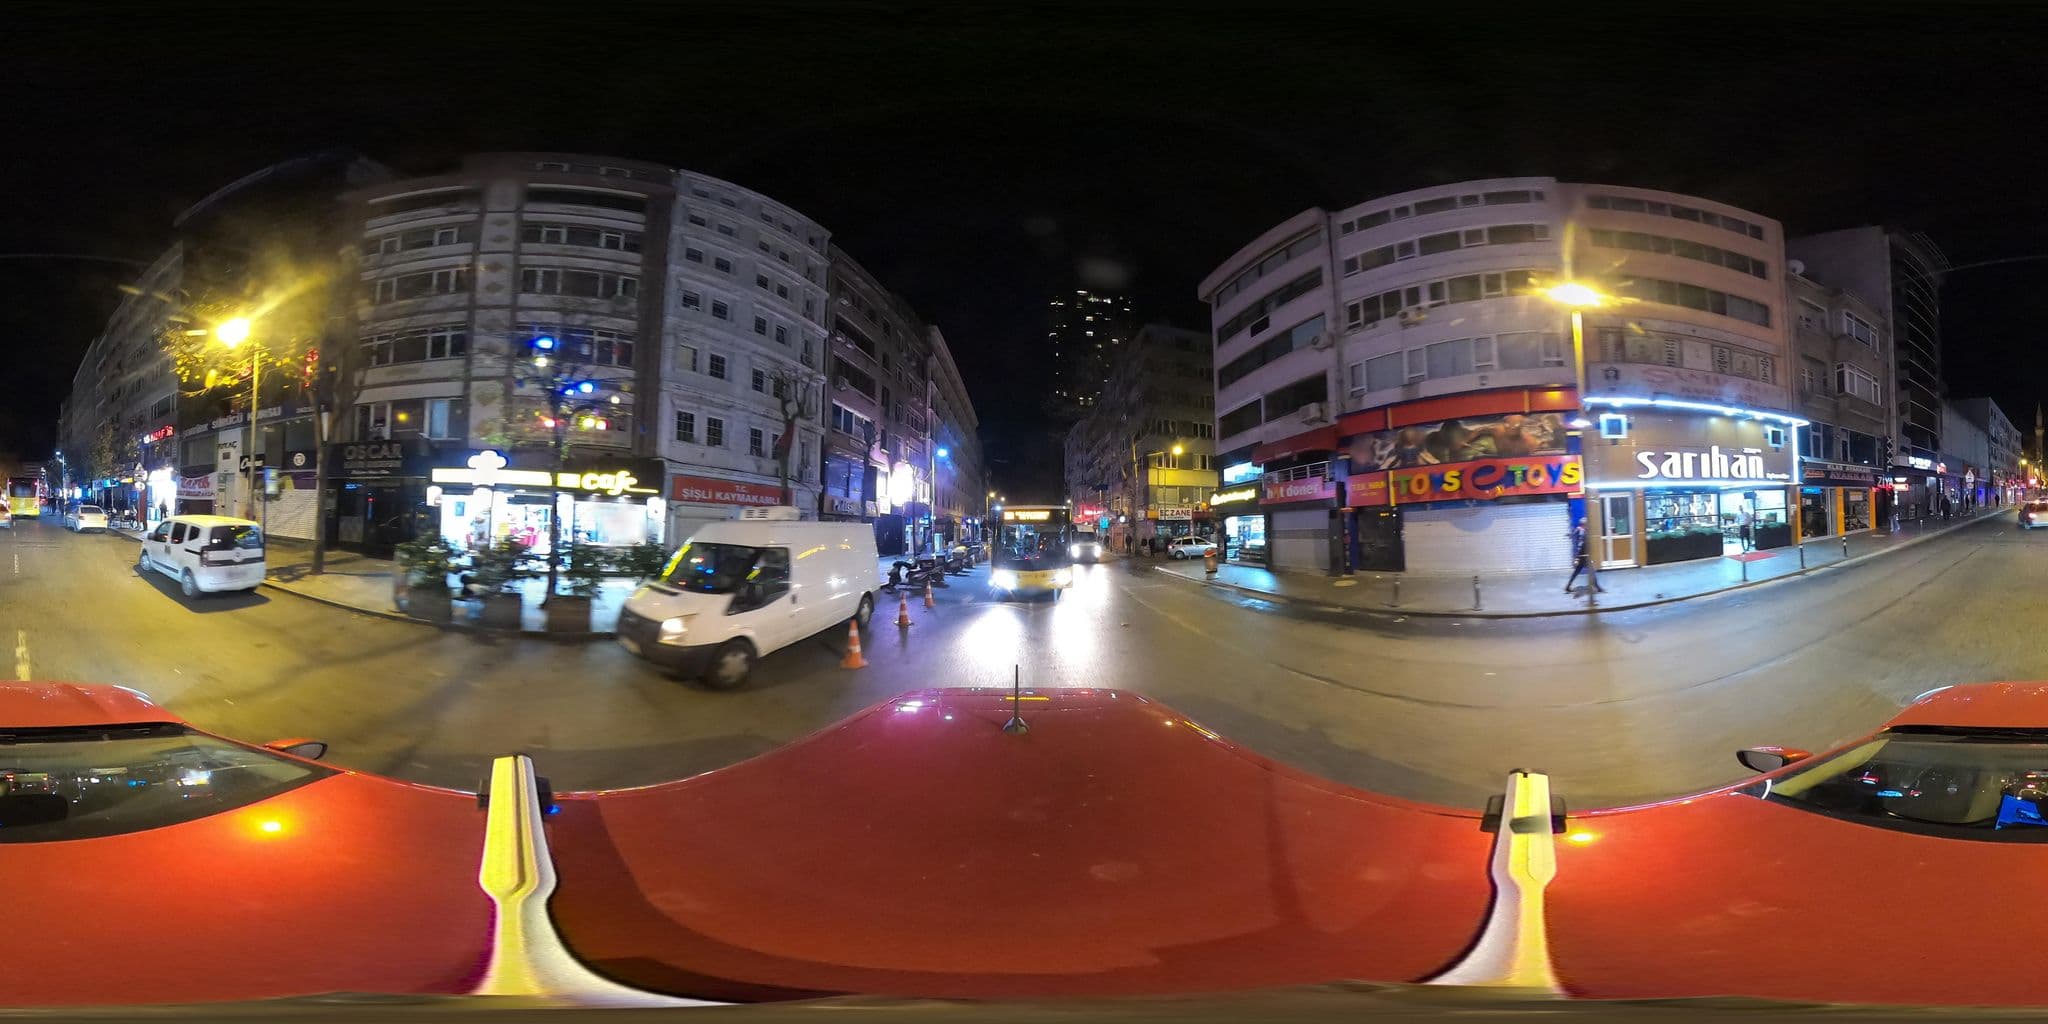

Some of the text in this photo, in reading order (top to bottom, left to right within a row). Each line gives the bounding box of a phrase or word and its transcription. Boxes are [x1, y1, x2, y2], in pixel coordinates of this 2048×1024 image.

[344, 445, 402, 459] OSCAR
[1396, 470, 1461, 496] TOYS
[1508, 462, 1580, 487] TOYS
[682, 487, 781, 505] ŞİŞLİ KAYMAKAMLI
[1159, 509, 1191, 517] ECZANE
